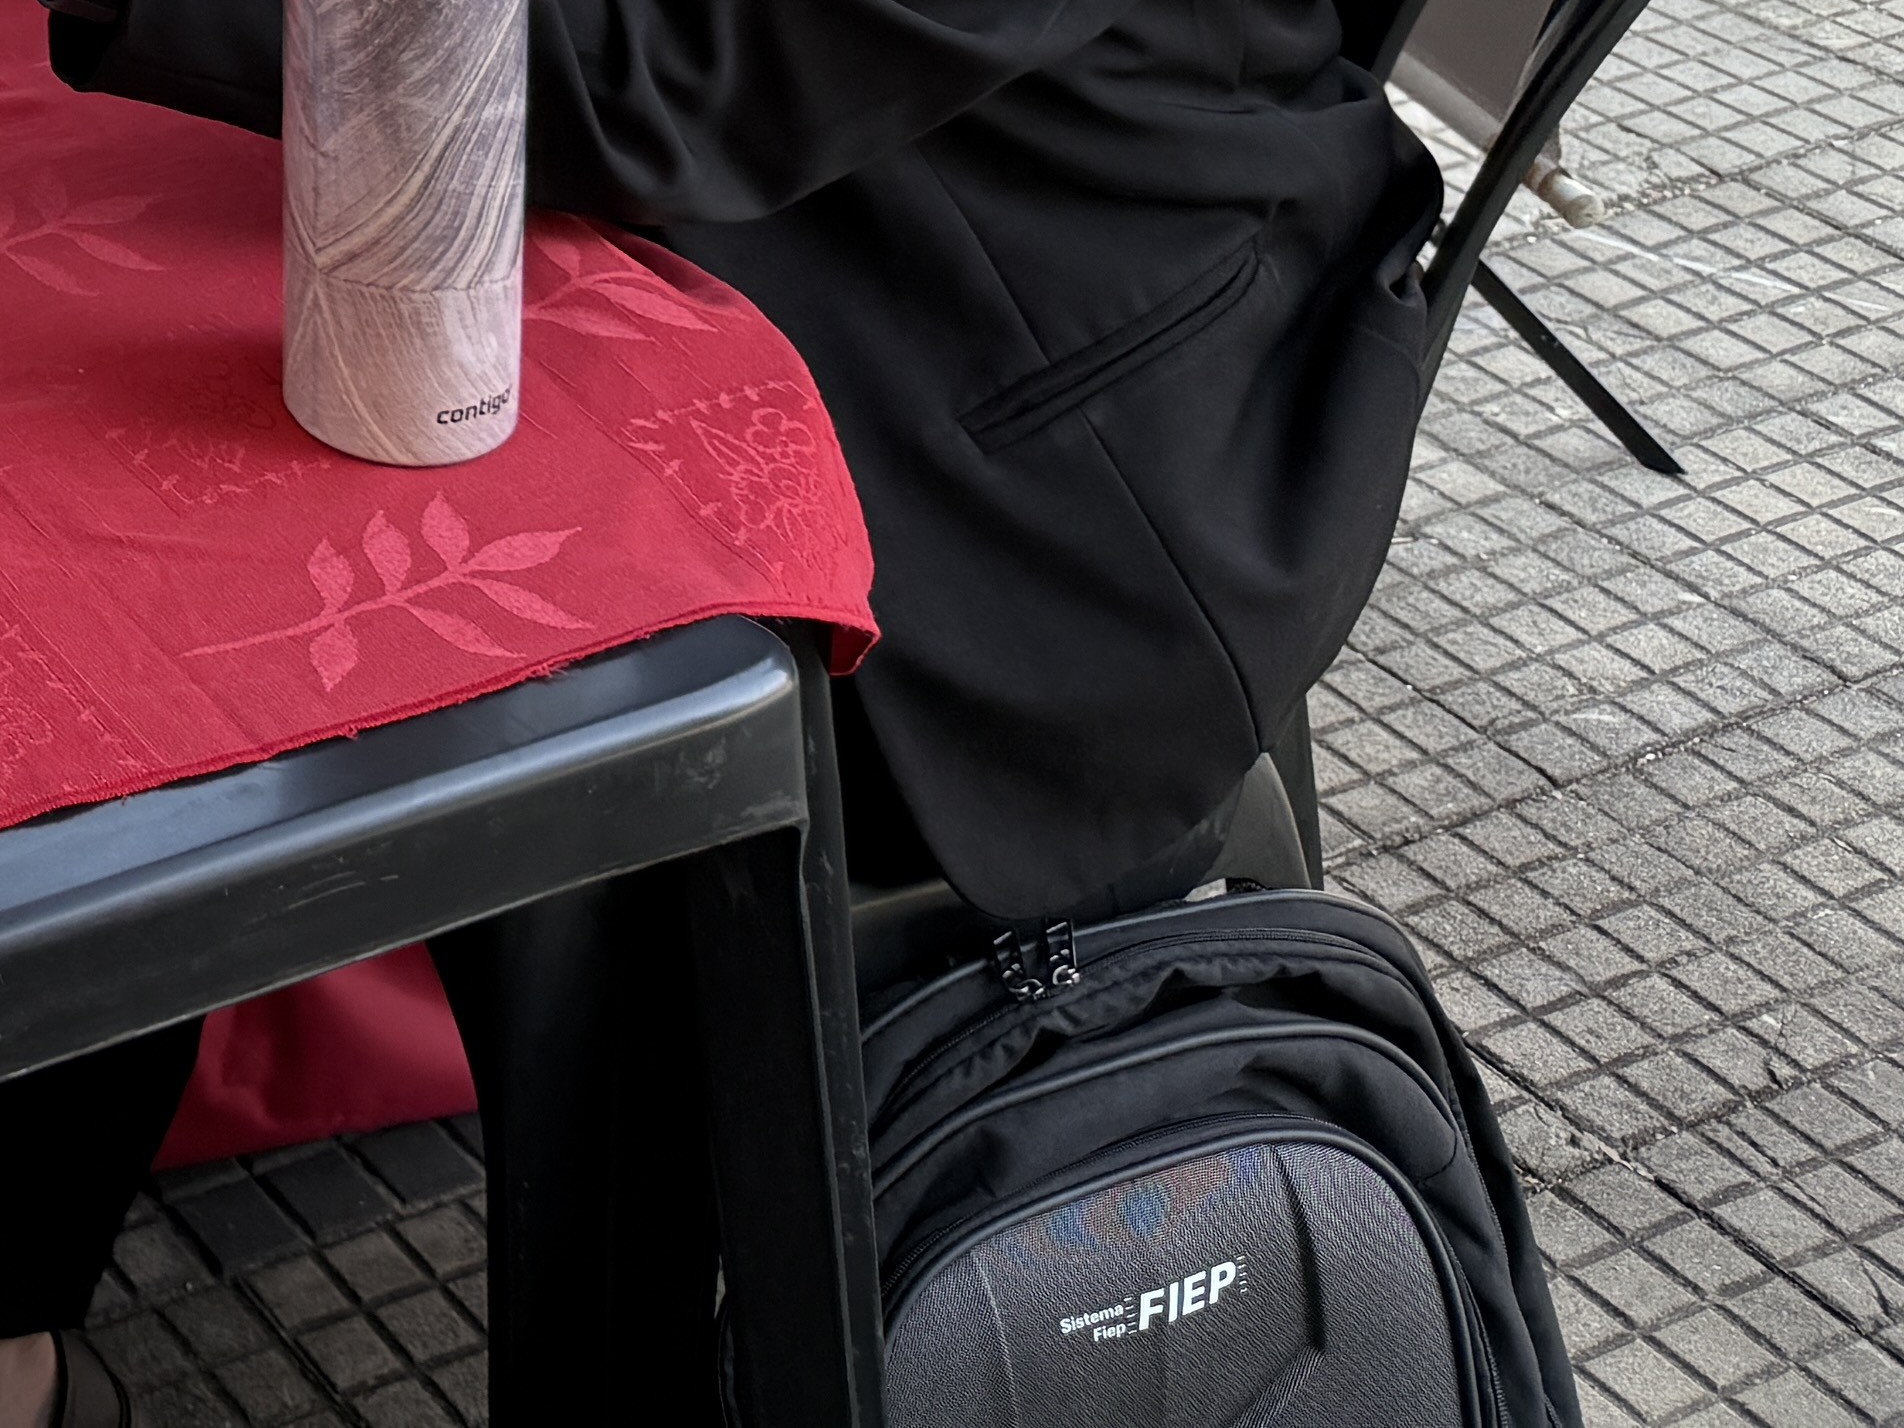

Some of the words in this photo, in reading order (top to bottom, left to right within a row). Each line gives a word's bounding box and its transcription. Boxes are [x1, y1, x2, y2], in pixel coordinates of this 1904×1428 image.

[437, 388, 511, 424] contigo
[1059, 1304, 1124, 1335] Sistema
[1093, 1322, 1126, 1342] Fiep
[1139, 1261, 1237, 1331] FIEP
